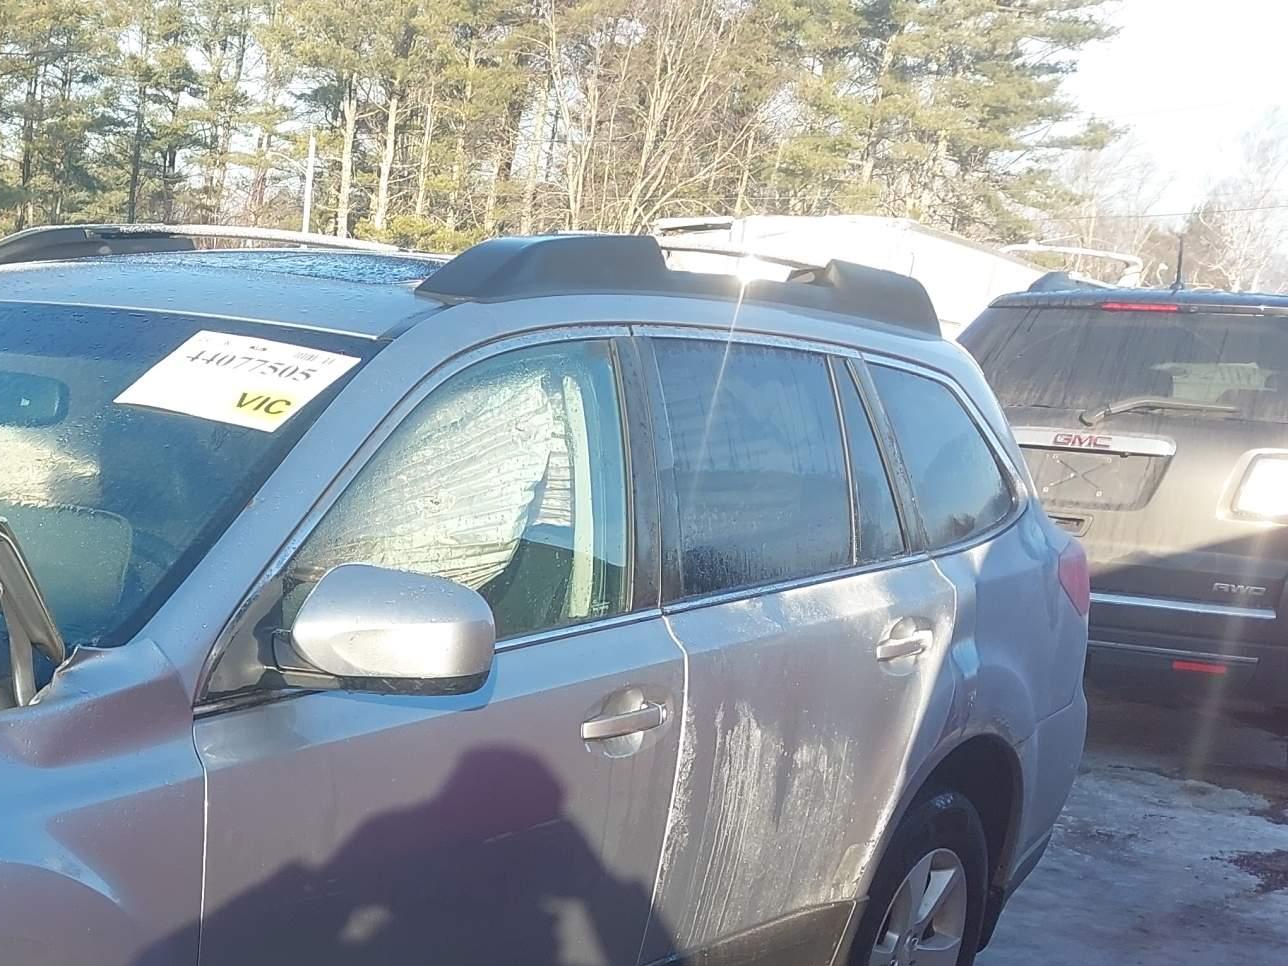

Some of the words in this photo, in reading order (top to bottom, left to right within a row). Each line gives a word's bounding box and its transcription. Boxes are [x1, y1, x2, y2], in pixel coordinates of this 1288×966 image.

[186, 350, 318, 382] 44077505
[235, 392, 292, 415] VIC
[1053, 433, 1113, 448] GMC
